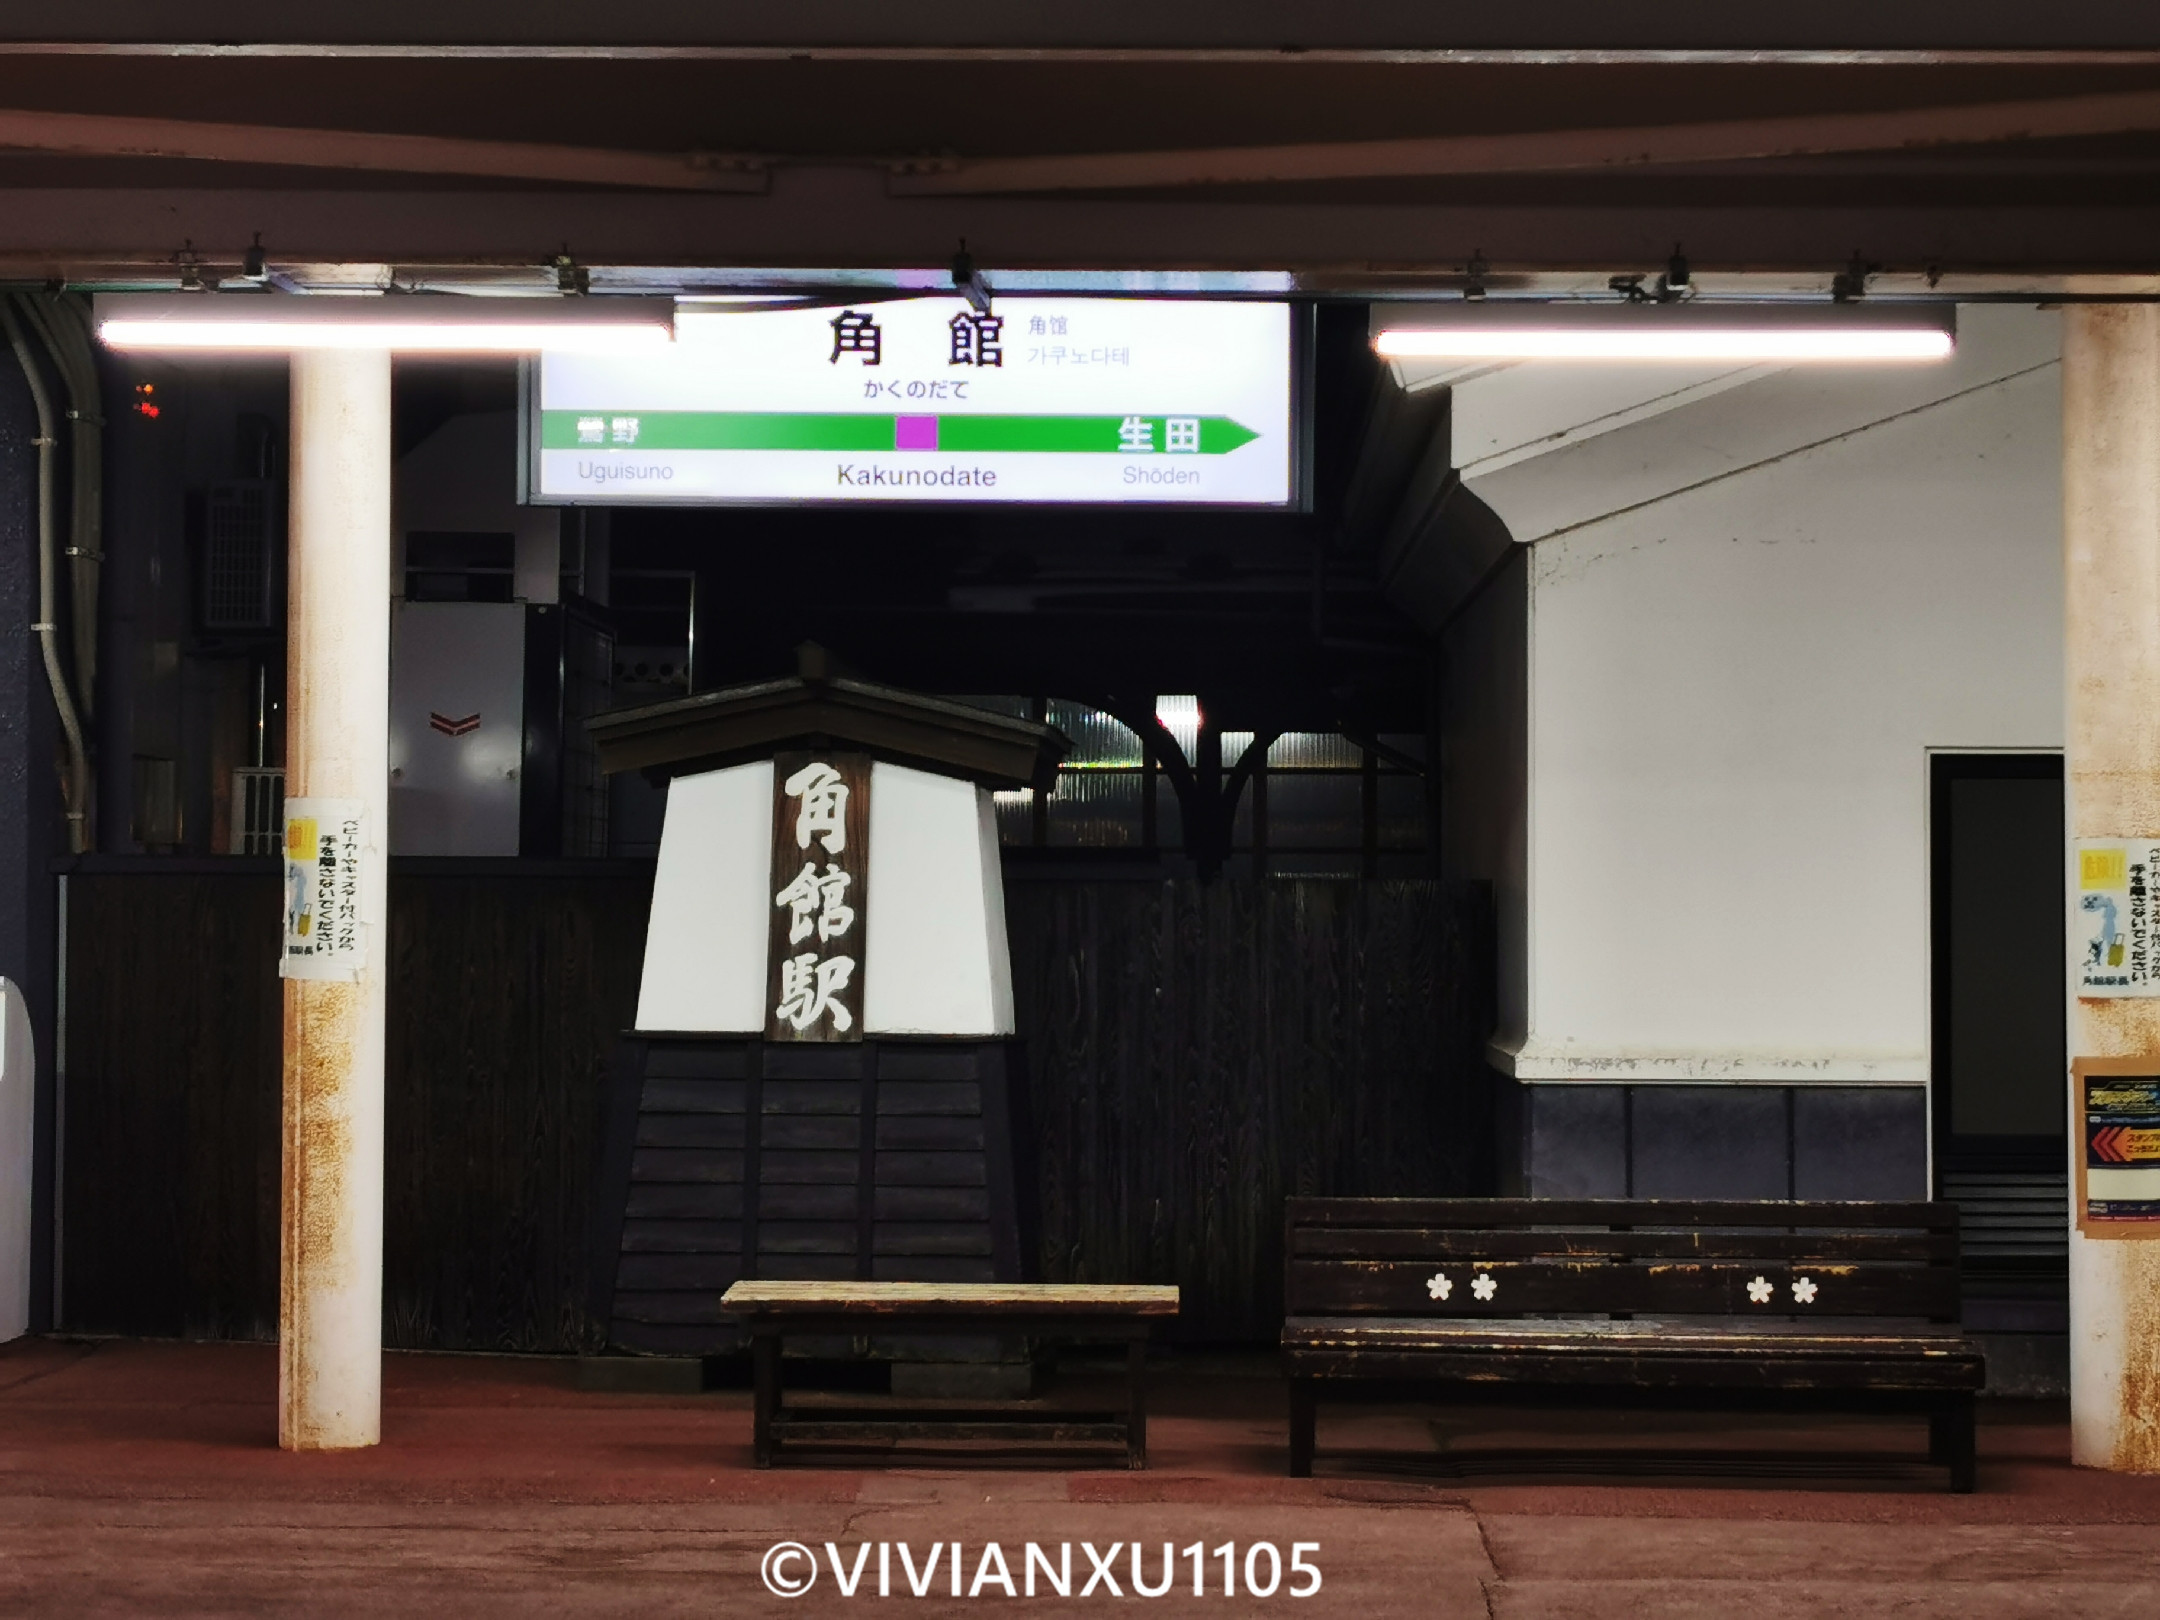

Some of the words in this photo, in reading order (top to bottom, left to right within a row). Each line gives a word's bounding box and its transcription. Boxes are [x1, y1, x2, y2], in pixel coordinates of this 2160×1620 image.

[1029, 314, 1068, 336] 角馆
[828, 310, 1004, 367] 角館
[1028, 345, 1130, 367] 가쿠노다테
[864, 379, 970, 399] かくのだて
[1118, 416, 1201, 453] 生田
[578, 460, 674, 483] Uguisuno
[837, 464, 997, 486] Kakunodate
[775, 762, 856, 1032] 角館駅
